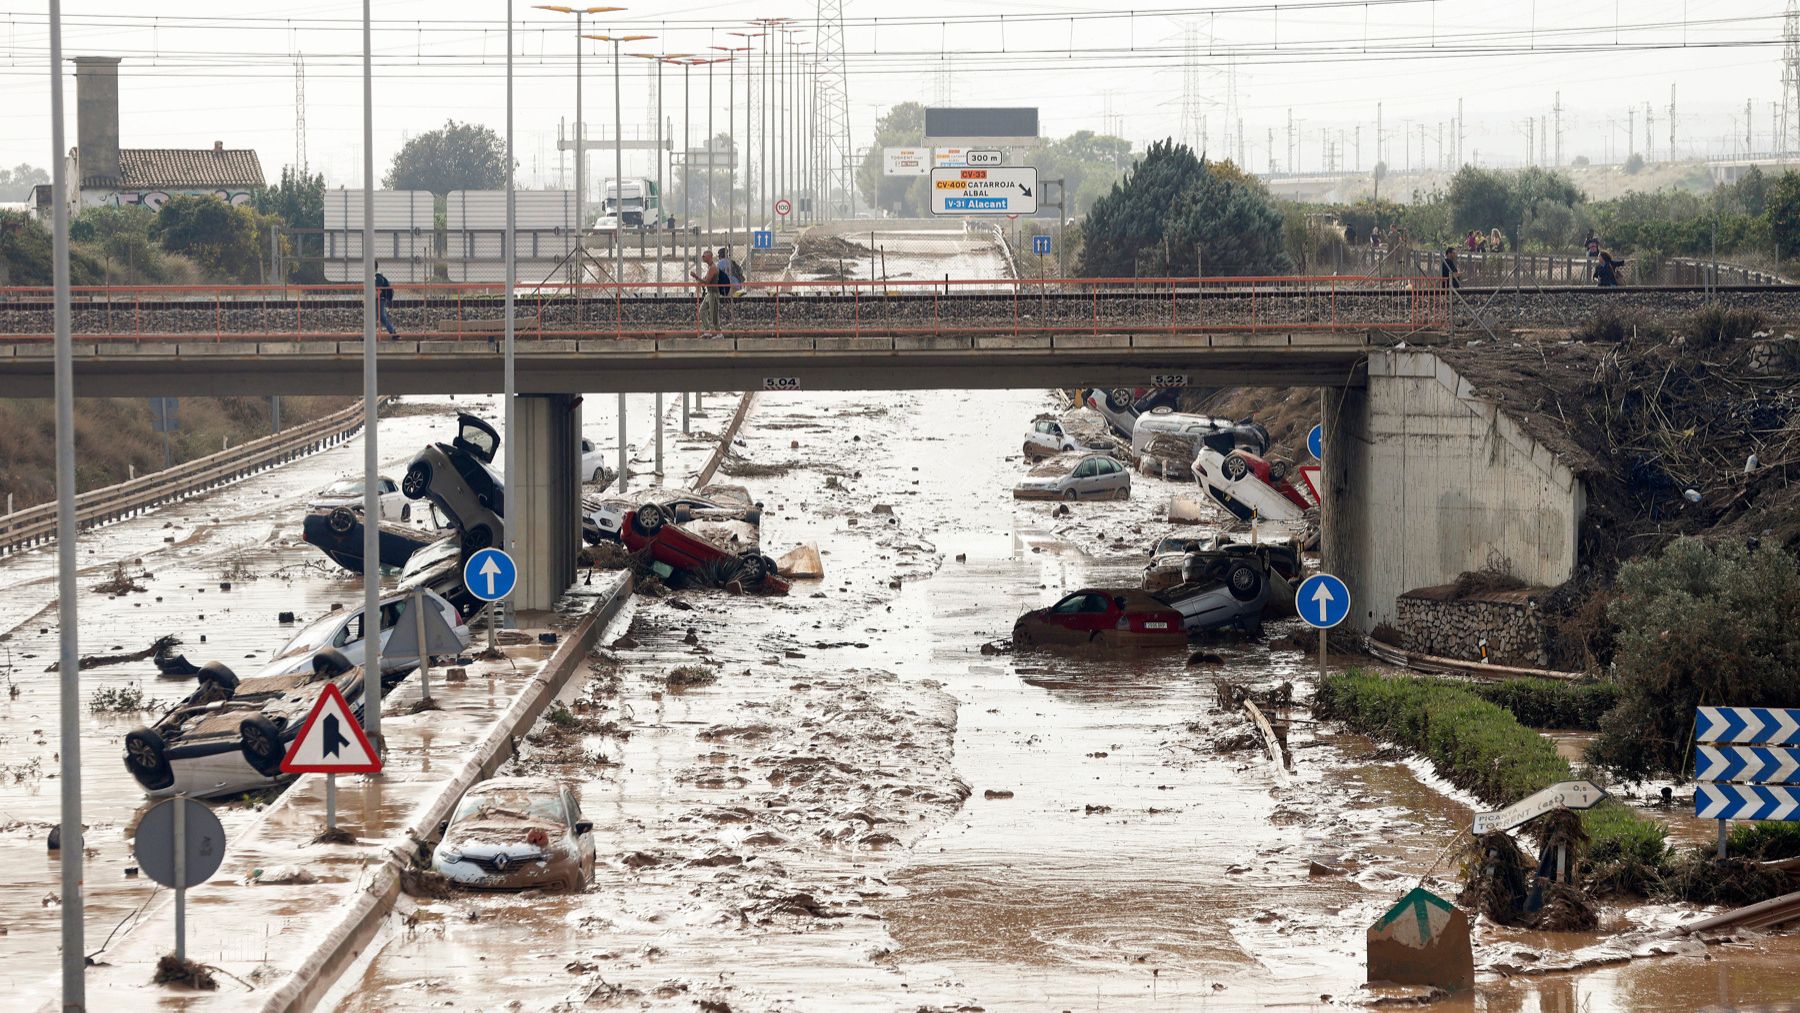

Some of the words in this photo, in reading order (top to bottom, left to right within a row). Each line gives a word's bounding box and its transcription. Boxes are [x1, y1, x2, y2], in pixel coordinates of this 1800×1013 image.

[971, 154, 988, 162] 300
[961, 170, 986, 179] CV-33
[936, 181, 966, 189] CV-400
[968, 181, 1015, 189] CATARROJA
[948, 200, 965, 208] V-31
[968, 200, 1007, 208] Alacant
[767, 378, 796, 387] 5.04
[1478, 808, 1531, 830] TORRENT
